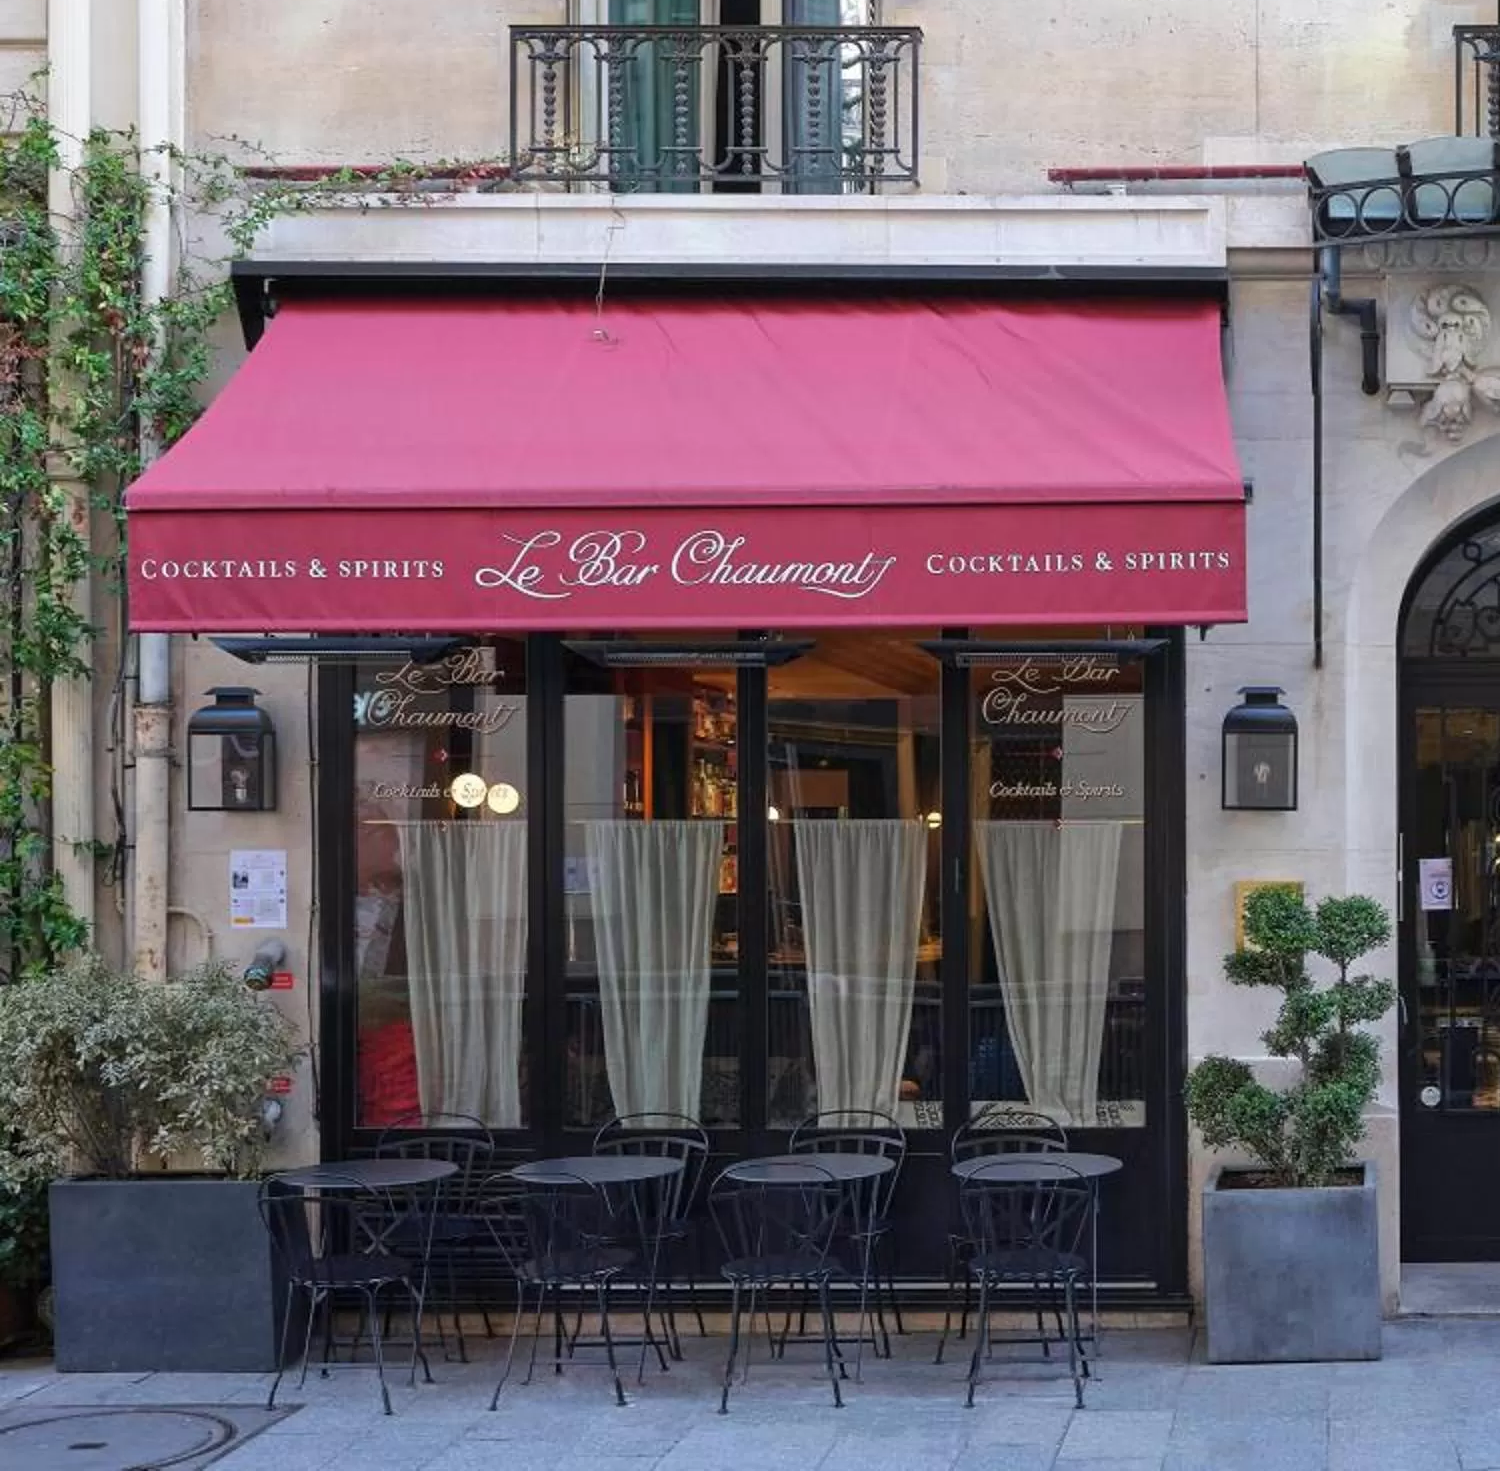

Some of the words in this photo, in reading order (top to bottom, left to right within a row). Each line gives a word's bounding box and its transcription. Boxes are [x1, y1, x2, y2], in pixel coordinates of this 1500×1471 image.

[140, 558, 297, 580] COCKTAILS
[308, 558, 328, 579] &
[338, 559, 445, 579] SPIRITS
[475, 530, 571, 599] Le
[559, 530, 660, 587] Bar
[671, 530, 897, 599] Chaumont
[926, 551, 1084, 575] COCKTAILS
[1095, 550, 1113, 572] &
[1124, 550, 1231, 572] SPIRITS
[376, 659, 447, 694] Le
[436, 646, 505, 684] Bar
[991, 656, 1061, 694] Le
[367, 688, 518, 734] Chaumont
[982, 686, 1135, 734] Chaumont
[989, 780, 1057, 798] Cocktails
[1075, 780, 1125, 801] Spirits
